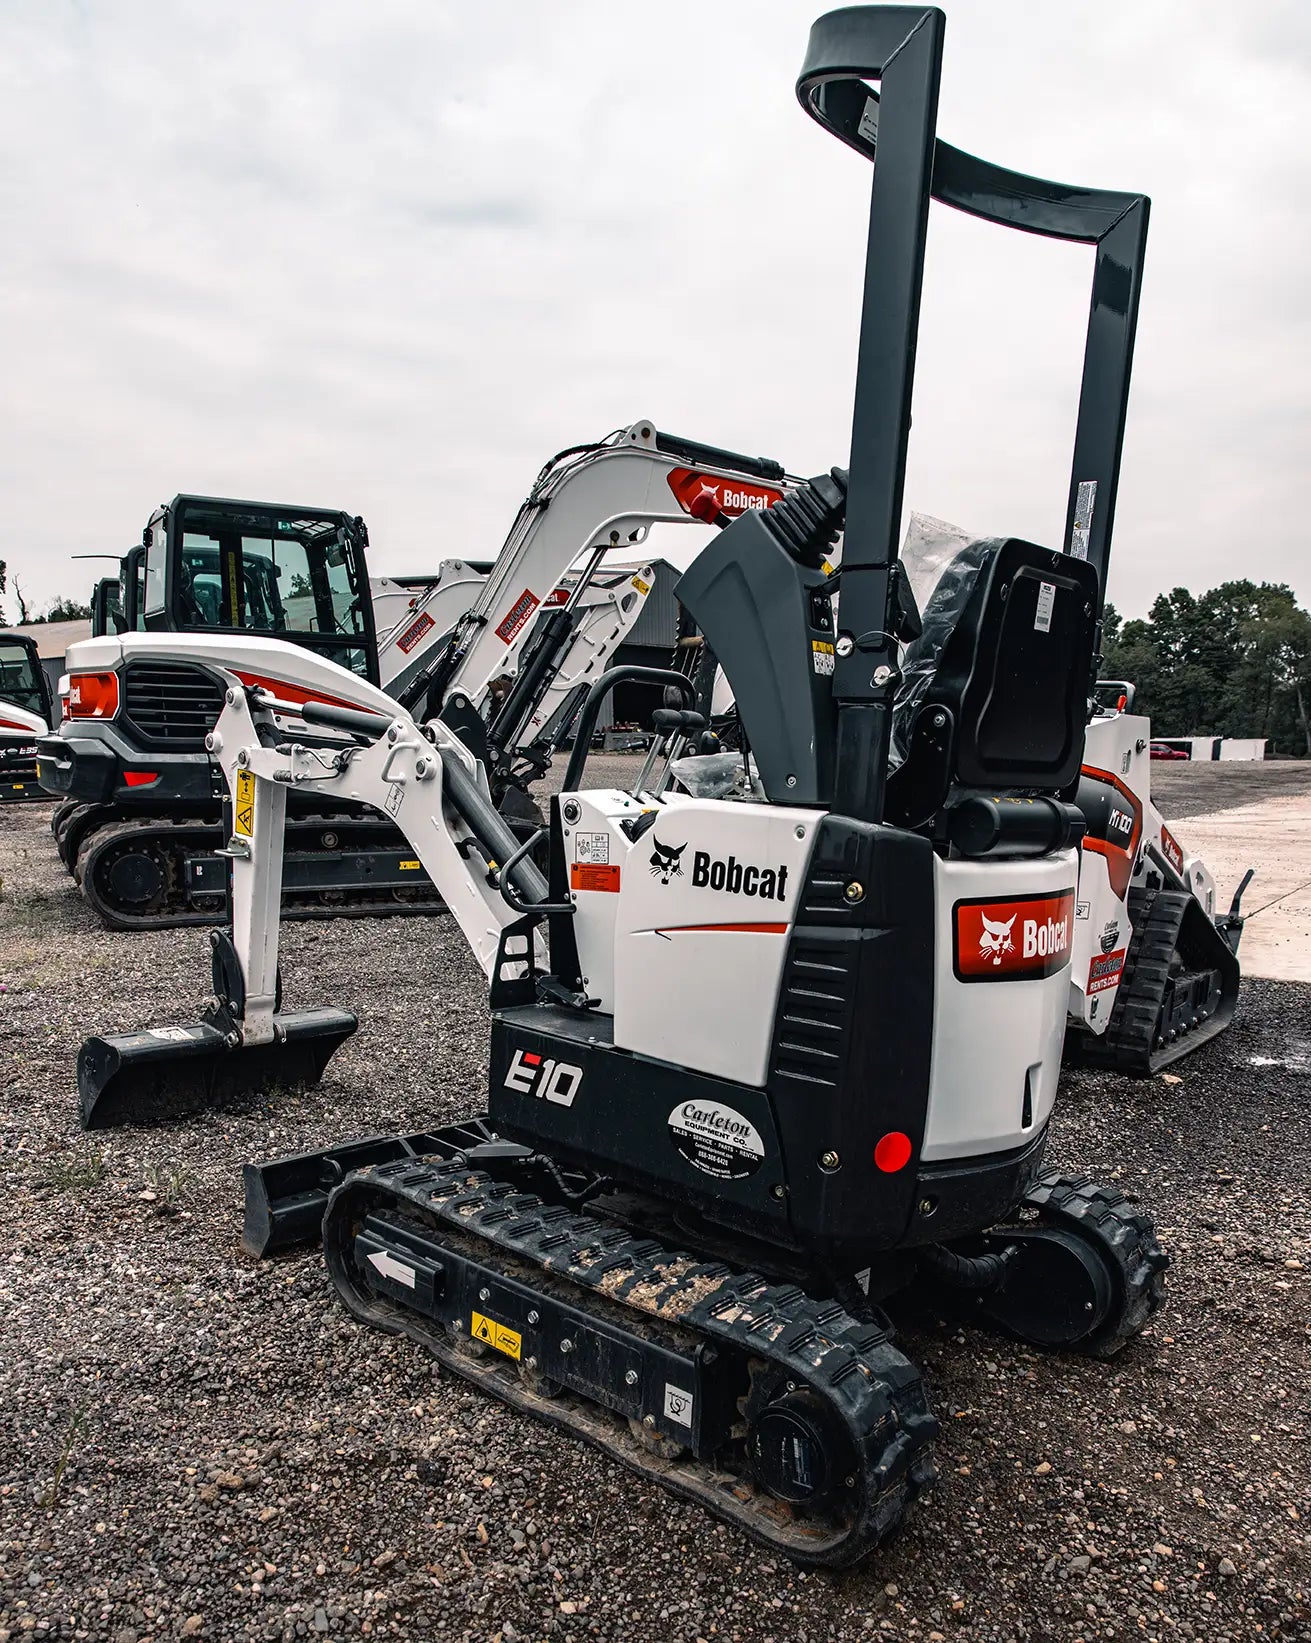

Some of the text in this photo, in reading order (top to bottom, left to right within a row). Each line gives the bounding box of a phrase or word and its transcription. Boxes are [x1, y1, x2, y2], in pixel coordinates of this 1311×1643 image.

[723, 489, 769, 509] Bobcat
[506, 602, 536, 641] RENTS.COM
[692, 850, 788, 902] Bobcat
[1023, 915, 1068, 958] Bobcat
[1089, 974, 1119, 992] RENTS.COM
[503, 1049, 583, 1107] E10
[681, 1103, 751, 1138] Carleton
[684, 1120, 748, 1147] EQUIPMENT CO.
[673, 1126, 688, 1137] SALES
[693, 1134, 713, 1146] SERVICE
[718, 1142, 734, 1153] PARTS
[739, 1150, 759, 1162] RENTAL
